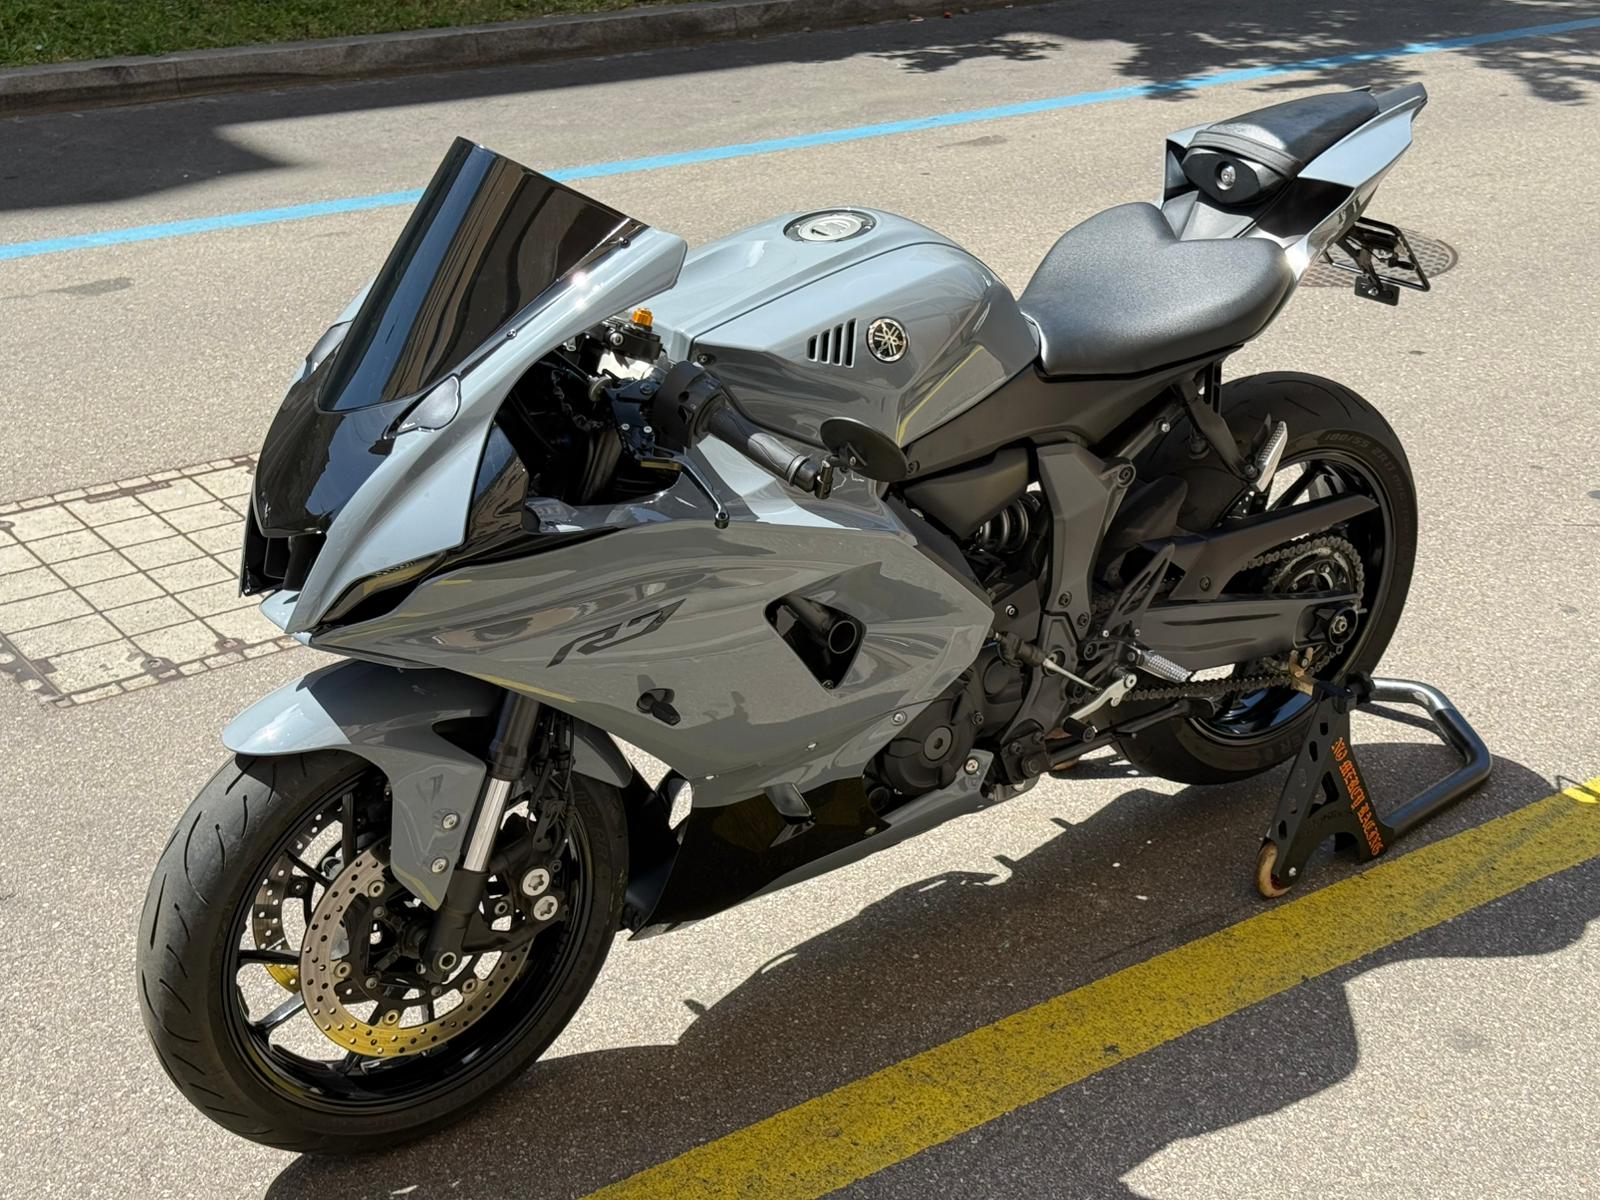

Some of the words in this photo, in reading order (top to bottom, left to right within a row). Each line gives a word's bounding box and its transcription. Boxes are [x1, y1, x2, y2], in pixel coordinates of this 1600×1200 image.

[546, 598, 687, 668] R7
[1339, 760, 1365, 811] MERCY
[1357, 803, 1384, 856] RACING
